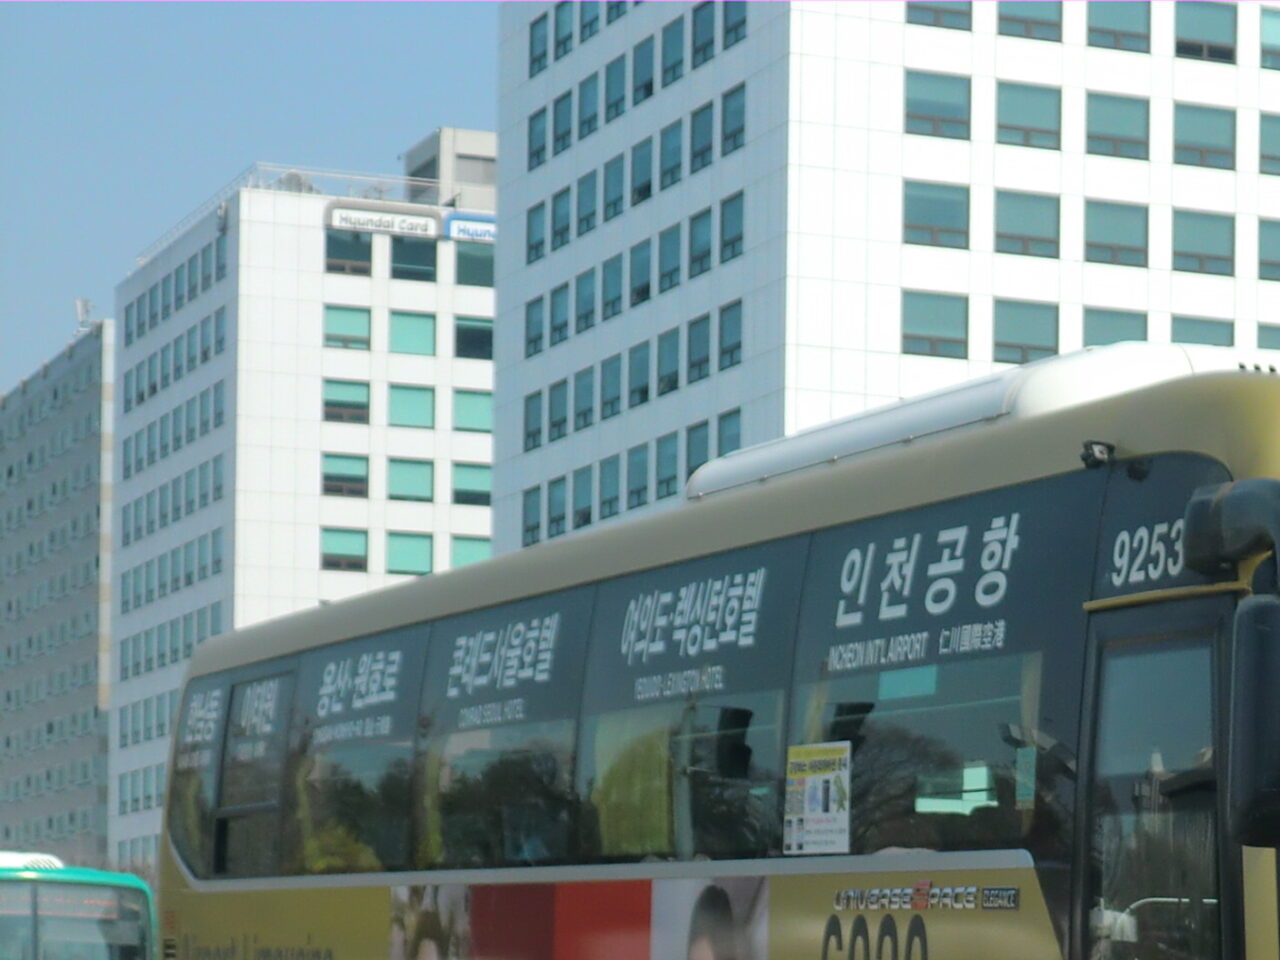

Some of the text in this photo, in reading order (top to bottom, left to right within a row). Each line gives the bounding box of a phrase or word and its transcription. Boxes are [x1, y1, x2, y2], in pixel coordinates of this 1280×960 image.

[338, 213, 429, 233] Hyundai Card
[835, 511, 1020, 629] 인천공항
[1109, 518, 1186, 588] 9253
[832, 887, 913, 911] UNIVERSE
